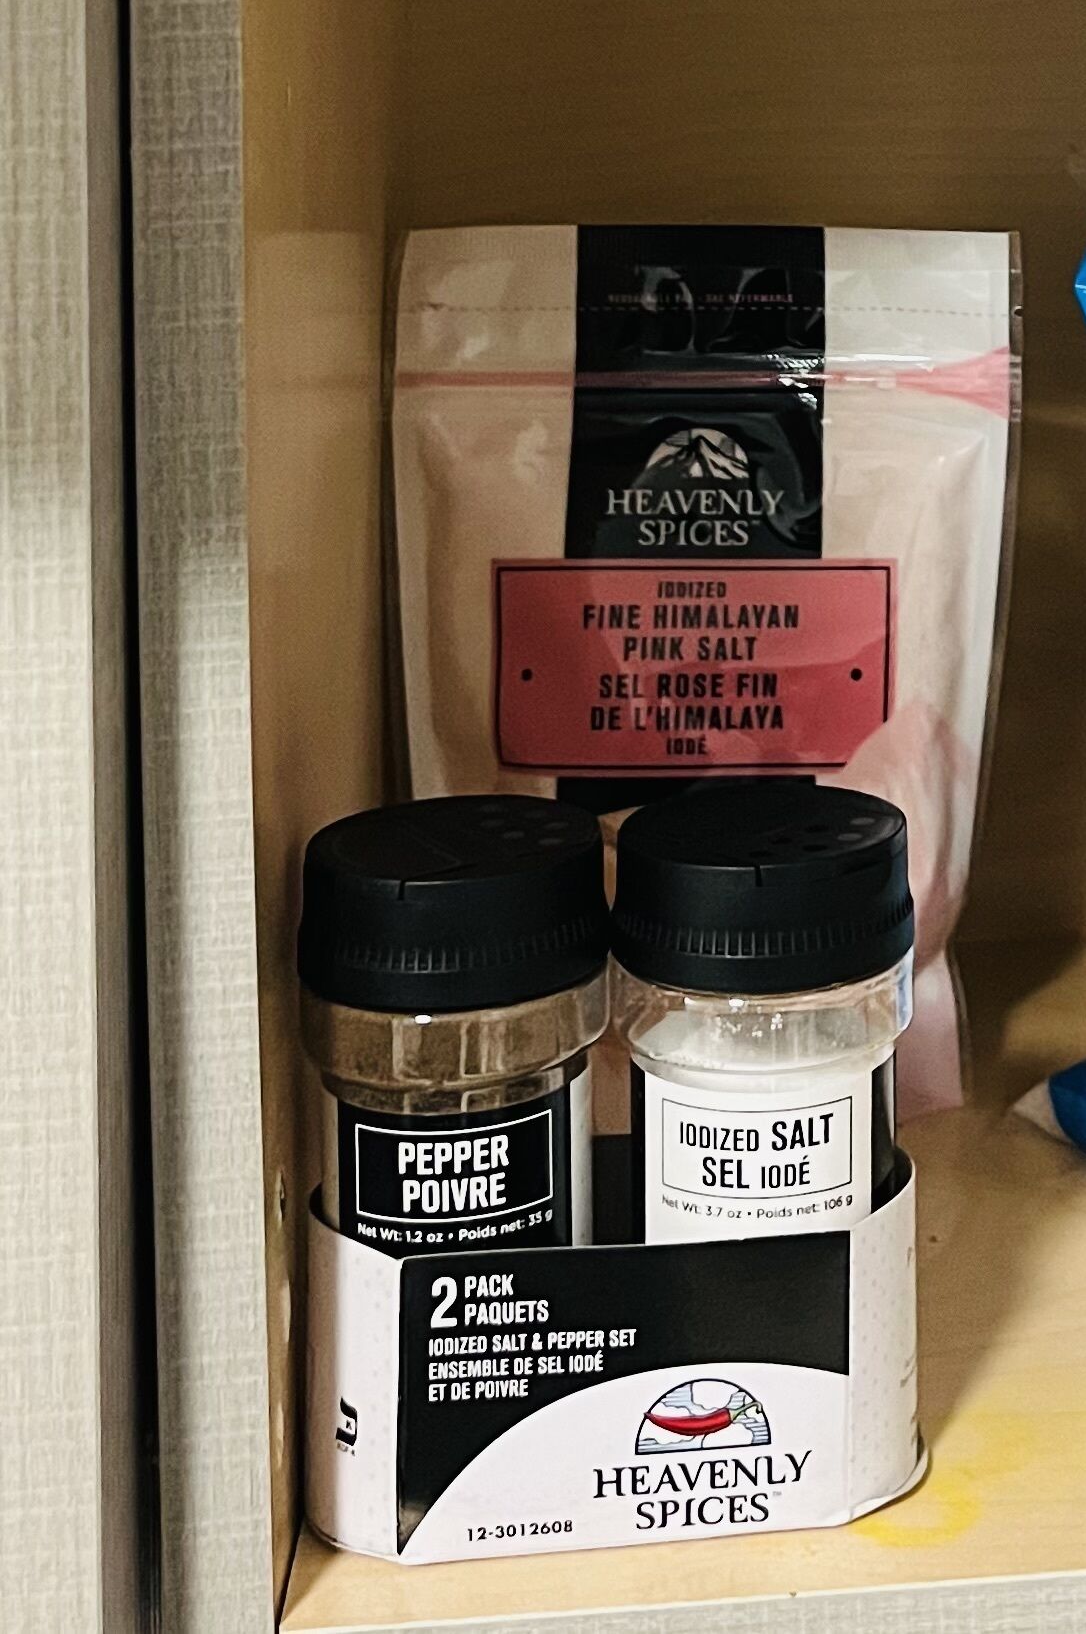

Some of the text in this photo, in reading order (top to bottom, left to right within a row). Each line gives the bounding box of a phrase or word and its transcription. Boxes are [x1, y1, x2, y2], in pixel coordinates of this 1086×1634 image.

[606, 488, 785, 516] HEAVENLY
[638, 519, 749, 546] SPICES
[657, 581, 726, 599] IODIZED
[583, 604, 799, 629] FINE HIMALAYAN
[623, 636, 757, 662] PINK SALT
[599, 673, 778, 699] SEL ROSE FIN
[590, 705, 784, 731] DE L'HIMALAYA
[679, 1113, 834, 1152] IODIZED SALT
[398, 1134, 510, 1175] PEPPER
[702, 1155, 811, 1189] SEL IODÉ
[403, 1172, 507, 1214] POIVRE
[727, 1210, 742, 1218] oz
[757, 1206, 793, 1219] Poids
[823, 1195, 843, 1210] 106
[845, 1194, 853, 1206] g
[357, 1222, 377, 1239] Net
[405, 1230, 423, 1243] 1.2
[426, 1232, 444, 1243] oz
[458, 1224, 497, 1242] Poids
[430, 1274, 514, 1329] 2 PACK
[464, 1299, 550, 1327] PAQUETS
[428, 1328, 637, 1356] IODIZED SALT & PEPPER SET
[428, 1350, 604, 1381] ENSEMBLE DE SEL IODÉ
[428, 1378, 529, 1402] ET DE POIVRE
[592, 1450, 813, 1499] HEAVENLY
[636, 1492, 770, 1529] SPICES
[467, 1520, 574, 1542] 12-3012608
